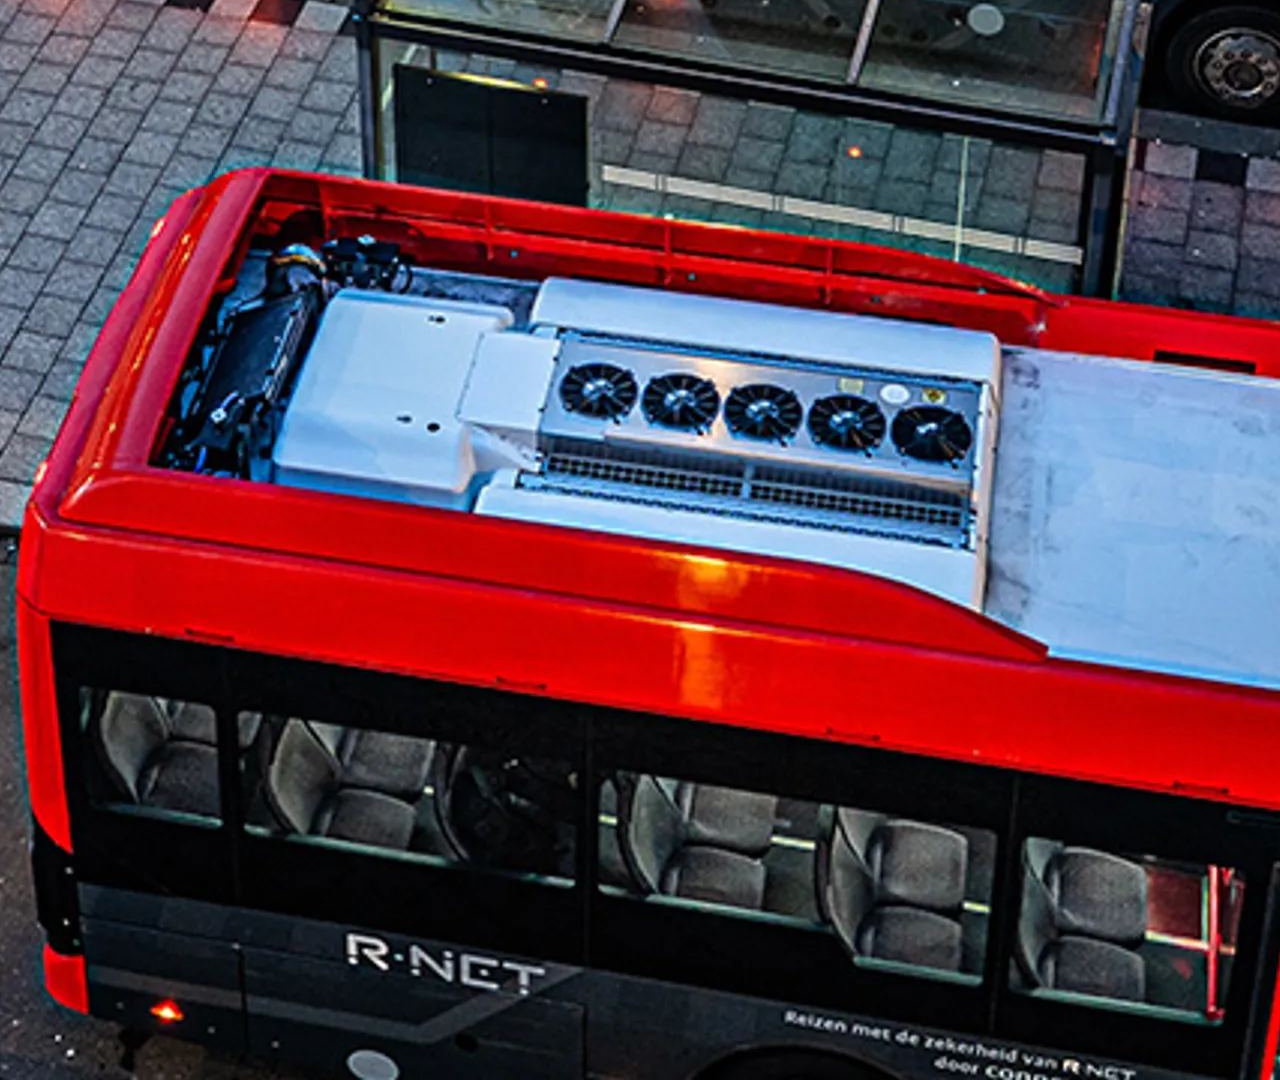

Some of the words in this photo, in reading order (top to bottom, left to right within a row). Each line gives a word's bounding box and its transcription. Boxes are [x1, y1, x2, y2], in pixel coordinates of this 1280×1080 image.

[785, 1010, 847, 1033] Reizen
[852, 1023, 891, 1041] met
[895, 1029, 920, 1046] de
[924, 1036, 1018, 1063] zekerheid
[1021, 1052, 1058, 1069] van
[934, 1055, 978, 1075] door
